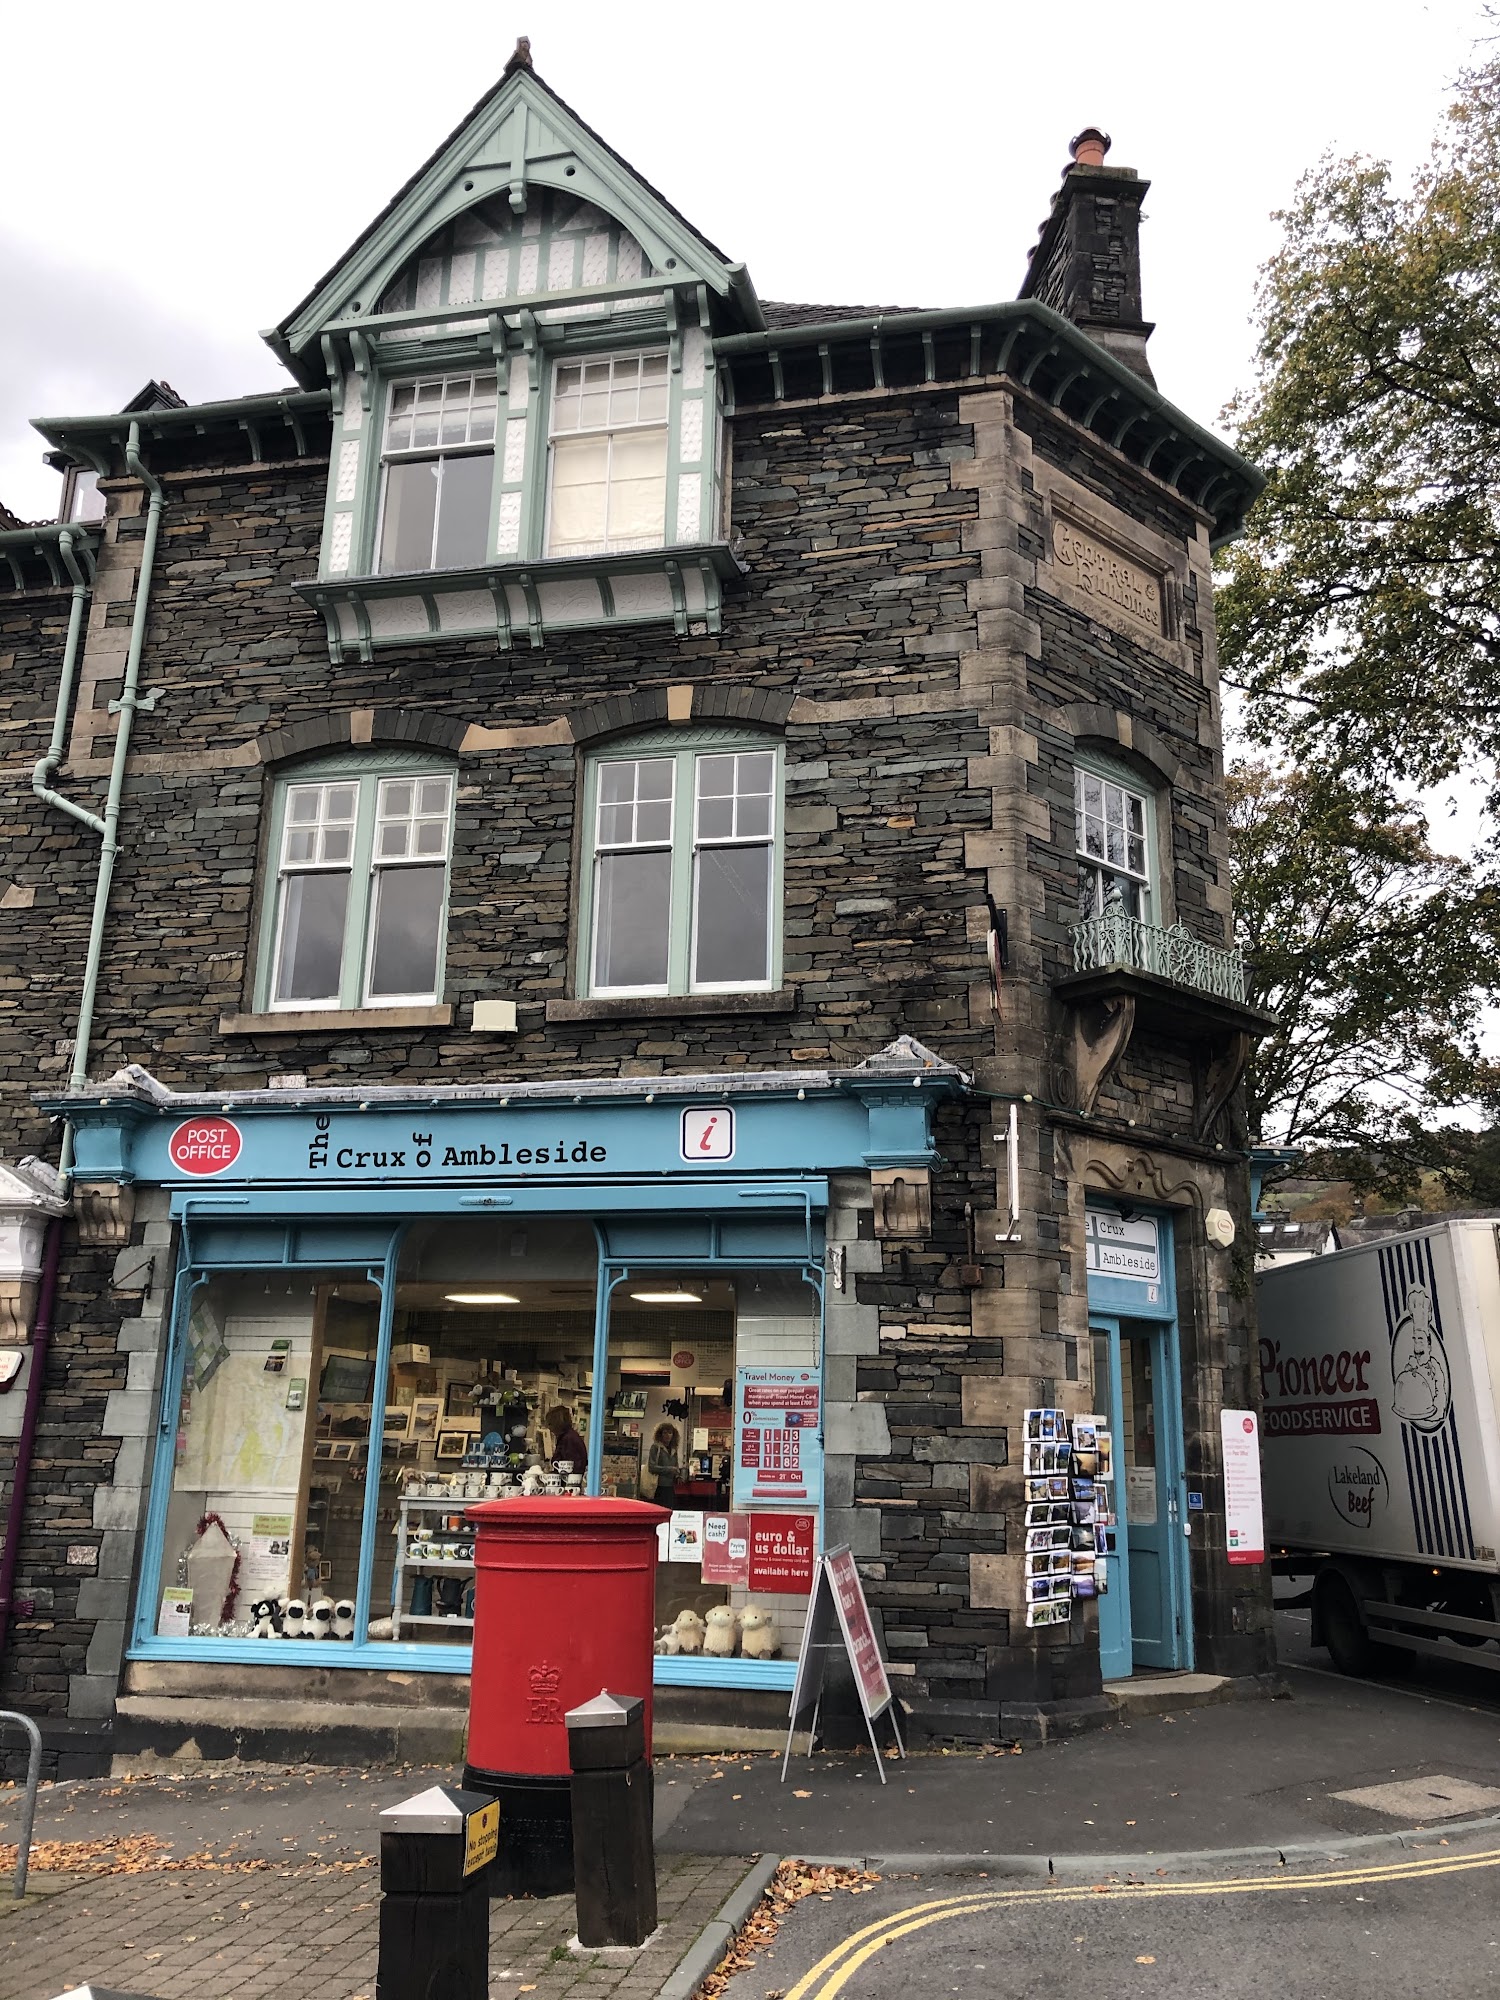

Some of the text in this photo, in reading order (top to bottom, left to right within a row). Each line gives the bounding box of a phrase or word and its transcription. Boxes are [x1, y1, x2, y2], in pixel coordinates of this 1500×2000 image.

[187, 1129, 228, 1143] POST
[309, 1114, 608, 1168] The Crux of Ambleside
[176, 1145, 231, 1160] OFFICE
[1100, 1222, 1125, 1236] Crux
[1103, 1252, 1156, 1270] Ambleside
[1258, 1337, 1371, 1399] Pioneer
[769, 1373, 796, 1383] Money
[1333, 1465, 1381, 1485] Lakeland
[1347, 1487, 1375, 1522] Beef
[755, 1531, 795, 1542] euro &
[755, 1543, 809, 1555] us dollar
[754, 1567, 808, 1577] available here
[469, 1828, 497, 1852] No stopping
